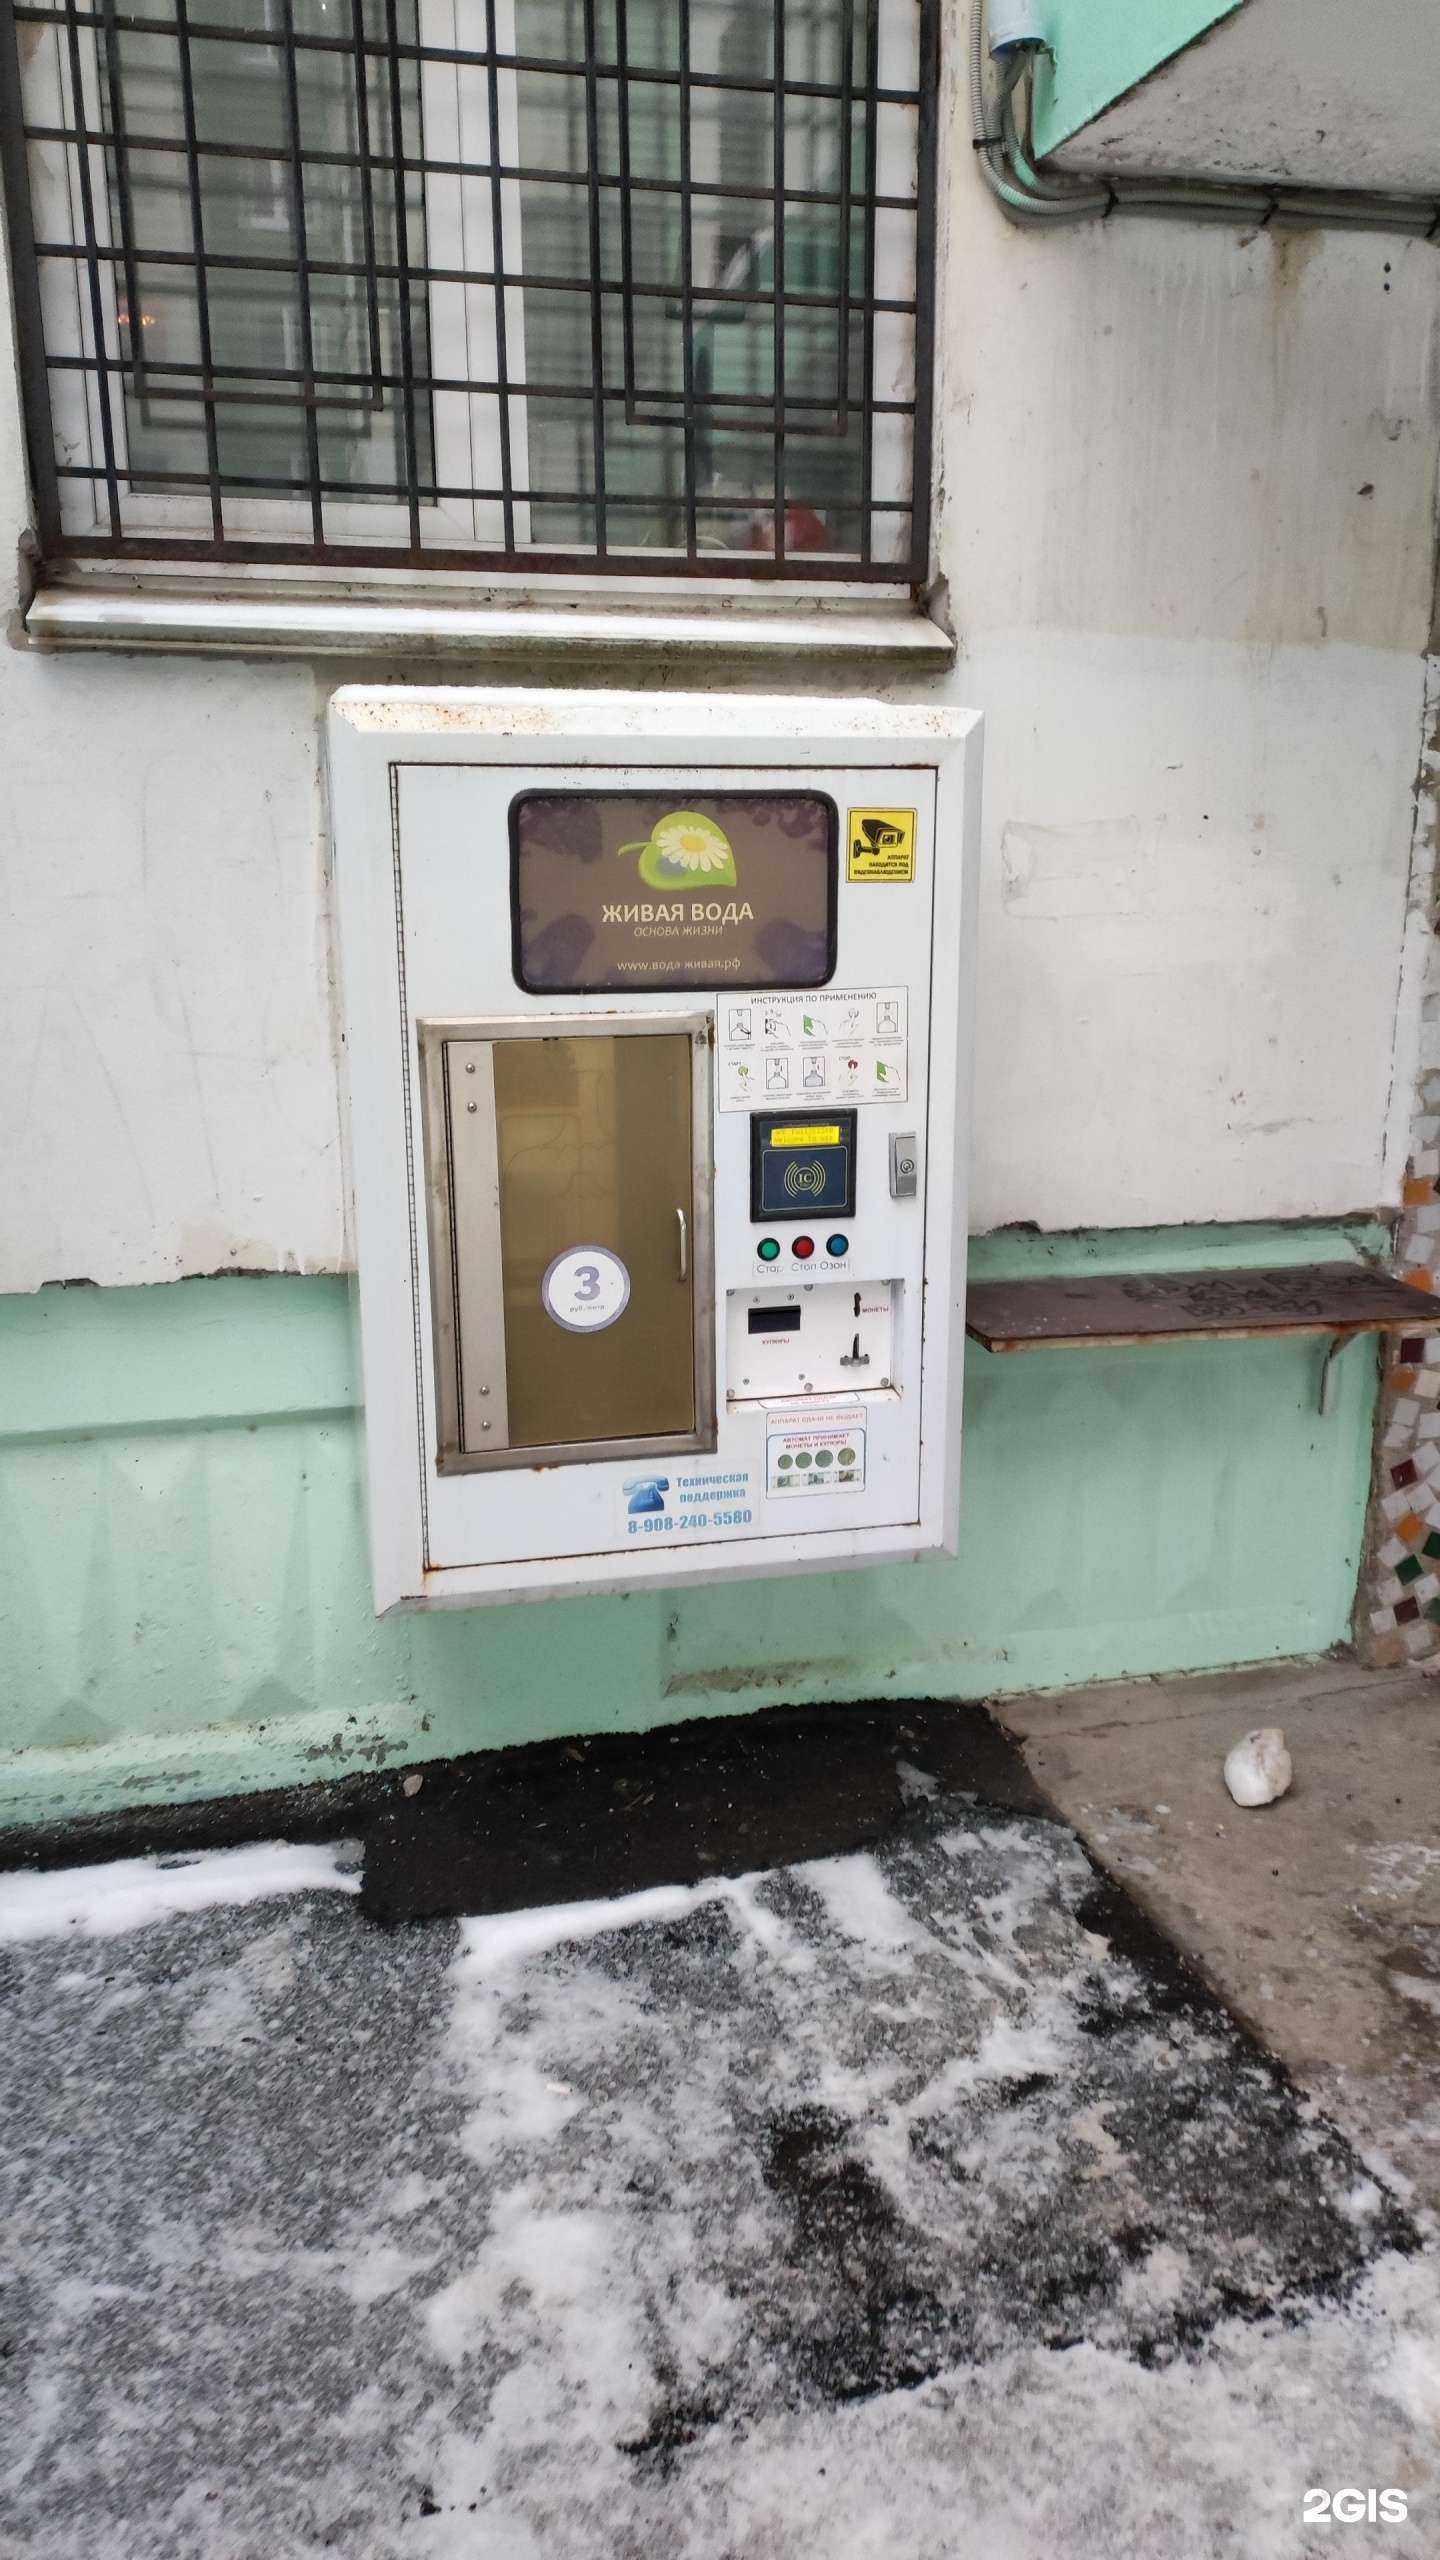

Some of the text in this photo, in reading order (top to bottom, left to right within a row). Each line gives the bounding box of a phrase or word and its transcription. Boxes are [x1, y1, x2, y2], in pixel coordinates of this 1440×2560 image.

[602, 902, 754, 926] ЖИВАЯ ВОДА
[633, 925, 723, 938] ОСНОВА ЖИЗНИ
[750, 991, 877, 1005] ИНСТРУКЦИЯ ПО ПРИМЕНЕНИЮ
[819, 1260, 847, 1270] Озон
[574, 1265, 601, 1301] 3
[677, 1472, 749, 1488] Техническая
[679, 1488, 747, 1503] поддержка
[627, 1509, 753, 1535] 8-908-240-5580
